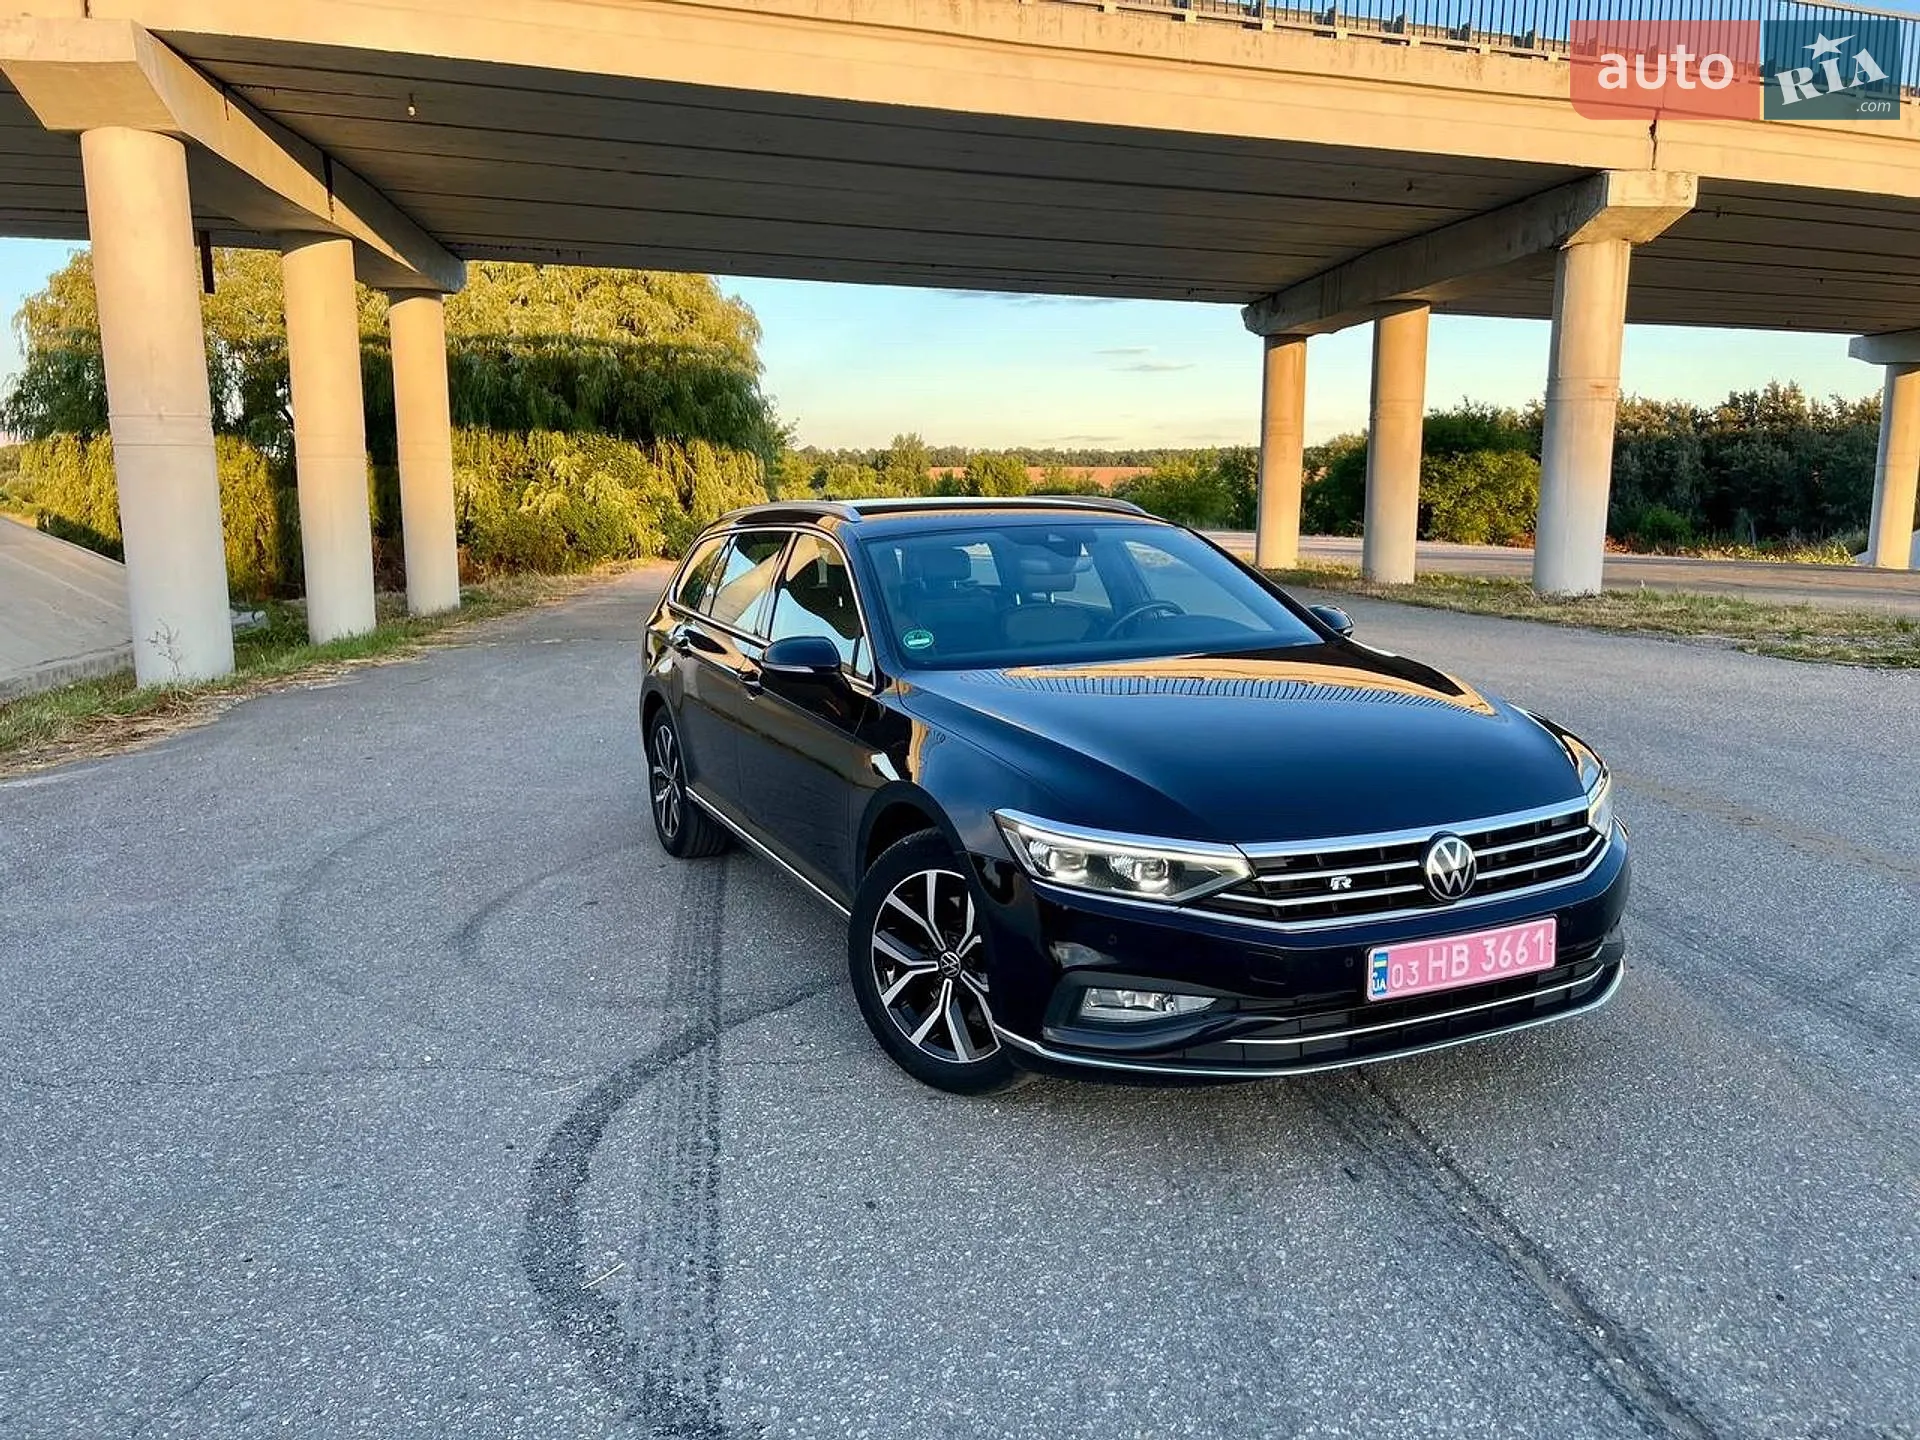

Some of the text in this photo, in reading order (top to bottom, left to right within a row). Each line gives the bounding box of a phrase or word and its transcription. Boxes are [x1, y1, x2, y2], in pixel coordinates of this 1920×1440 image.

[1391, 928, 1546, 988] 03 HB 3661
[1372, 979, 1387, 991] UA
